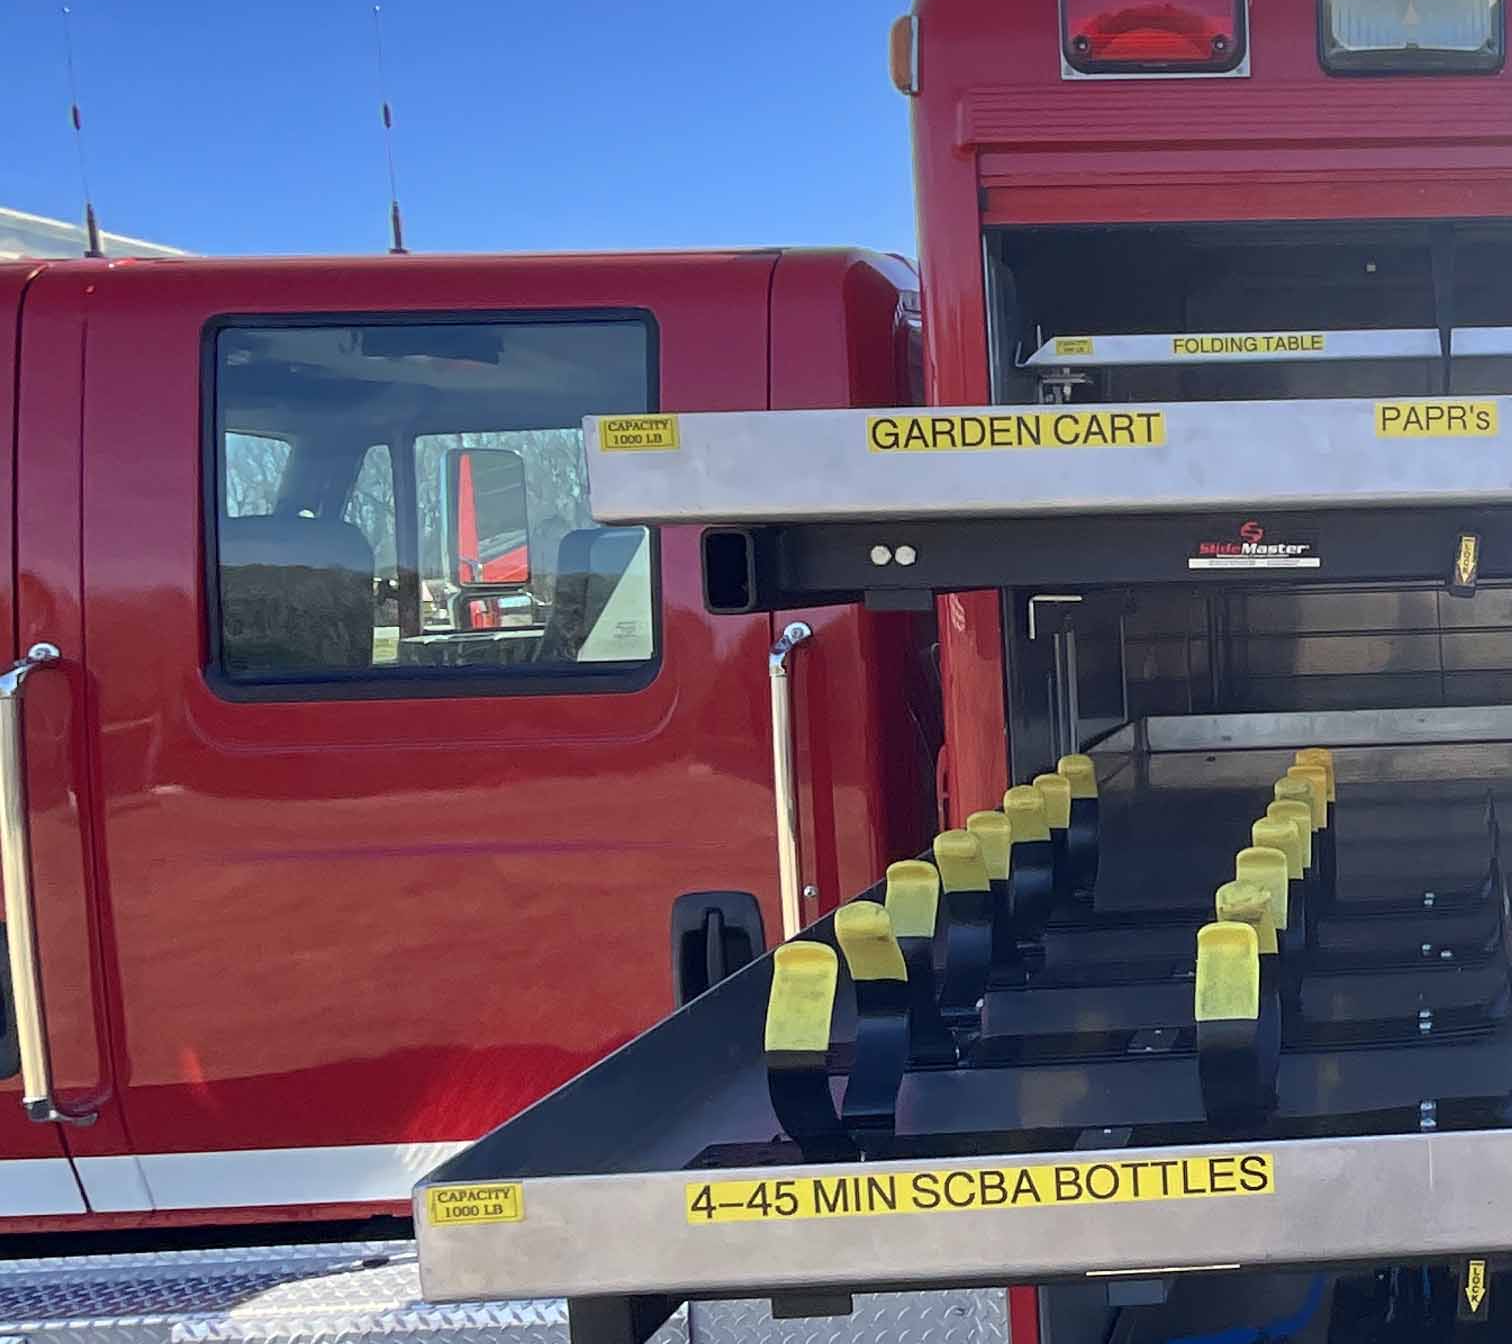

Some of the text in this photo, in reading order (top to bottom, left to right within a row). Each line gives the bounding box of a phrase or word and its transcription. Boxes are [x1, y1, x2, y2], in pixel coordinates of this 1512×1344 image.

[1173, 335, 1324, 354] FOLDING TABLE
[608, 418, 670, 432] CAPACITY
[1381, 405, 1490, 432] PAPR's
[614, 433, 663, 445] 1000 LB
[871, 413, 1161, 450] GARDEN CART
[437, 1187, 510, 1204] CAPACITY
[690, 1155, 1267, 1219] 4-45 MIN SCBA BOTTLES
[445, 1203, 504, 1218] 1000 LB
[1472, 1267, 1480, 1302] LOCK
